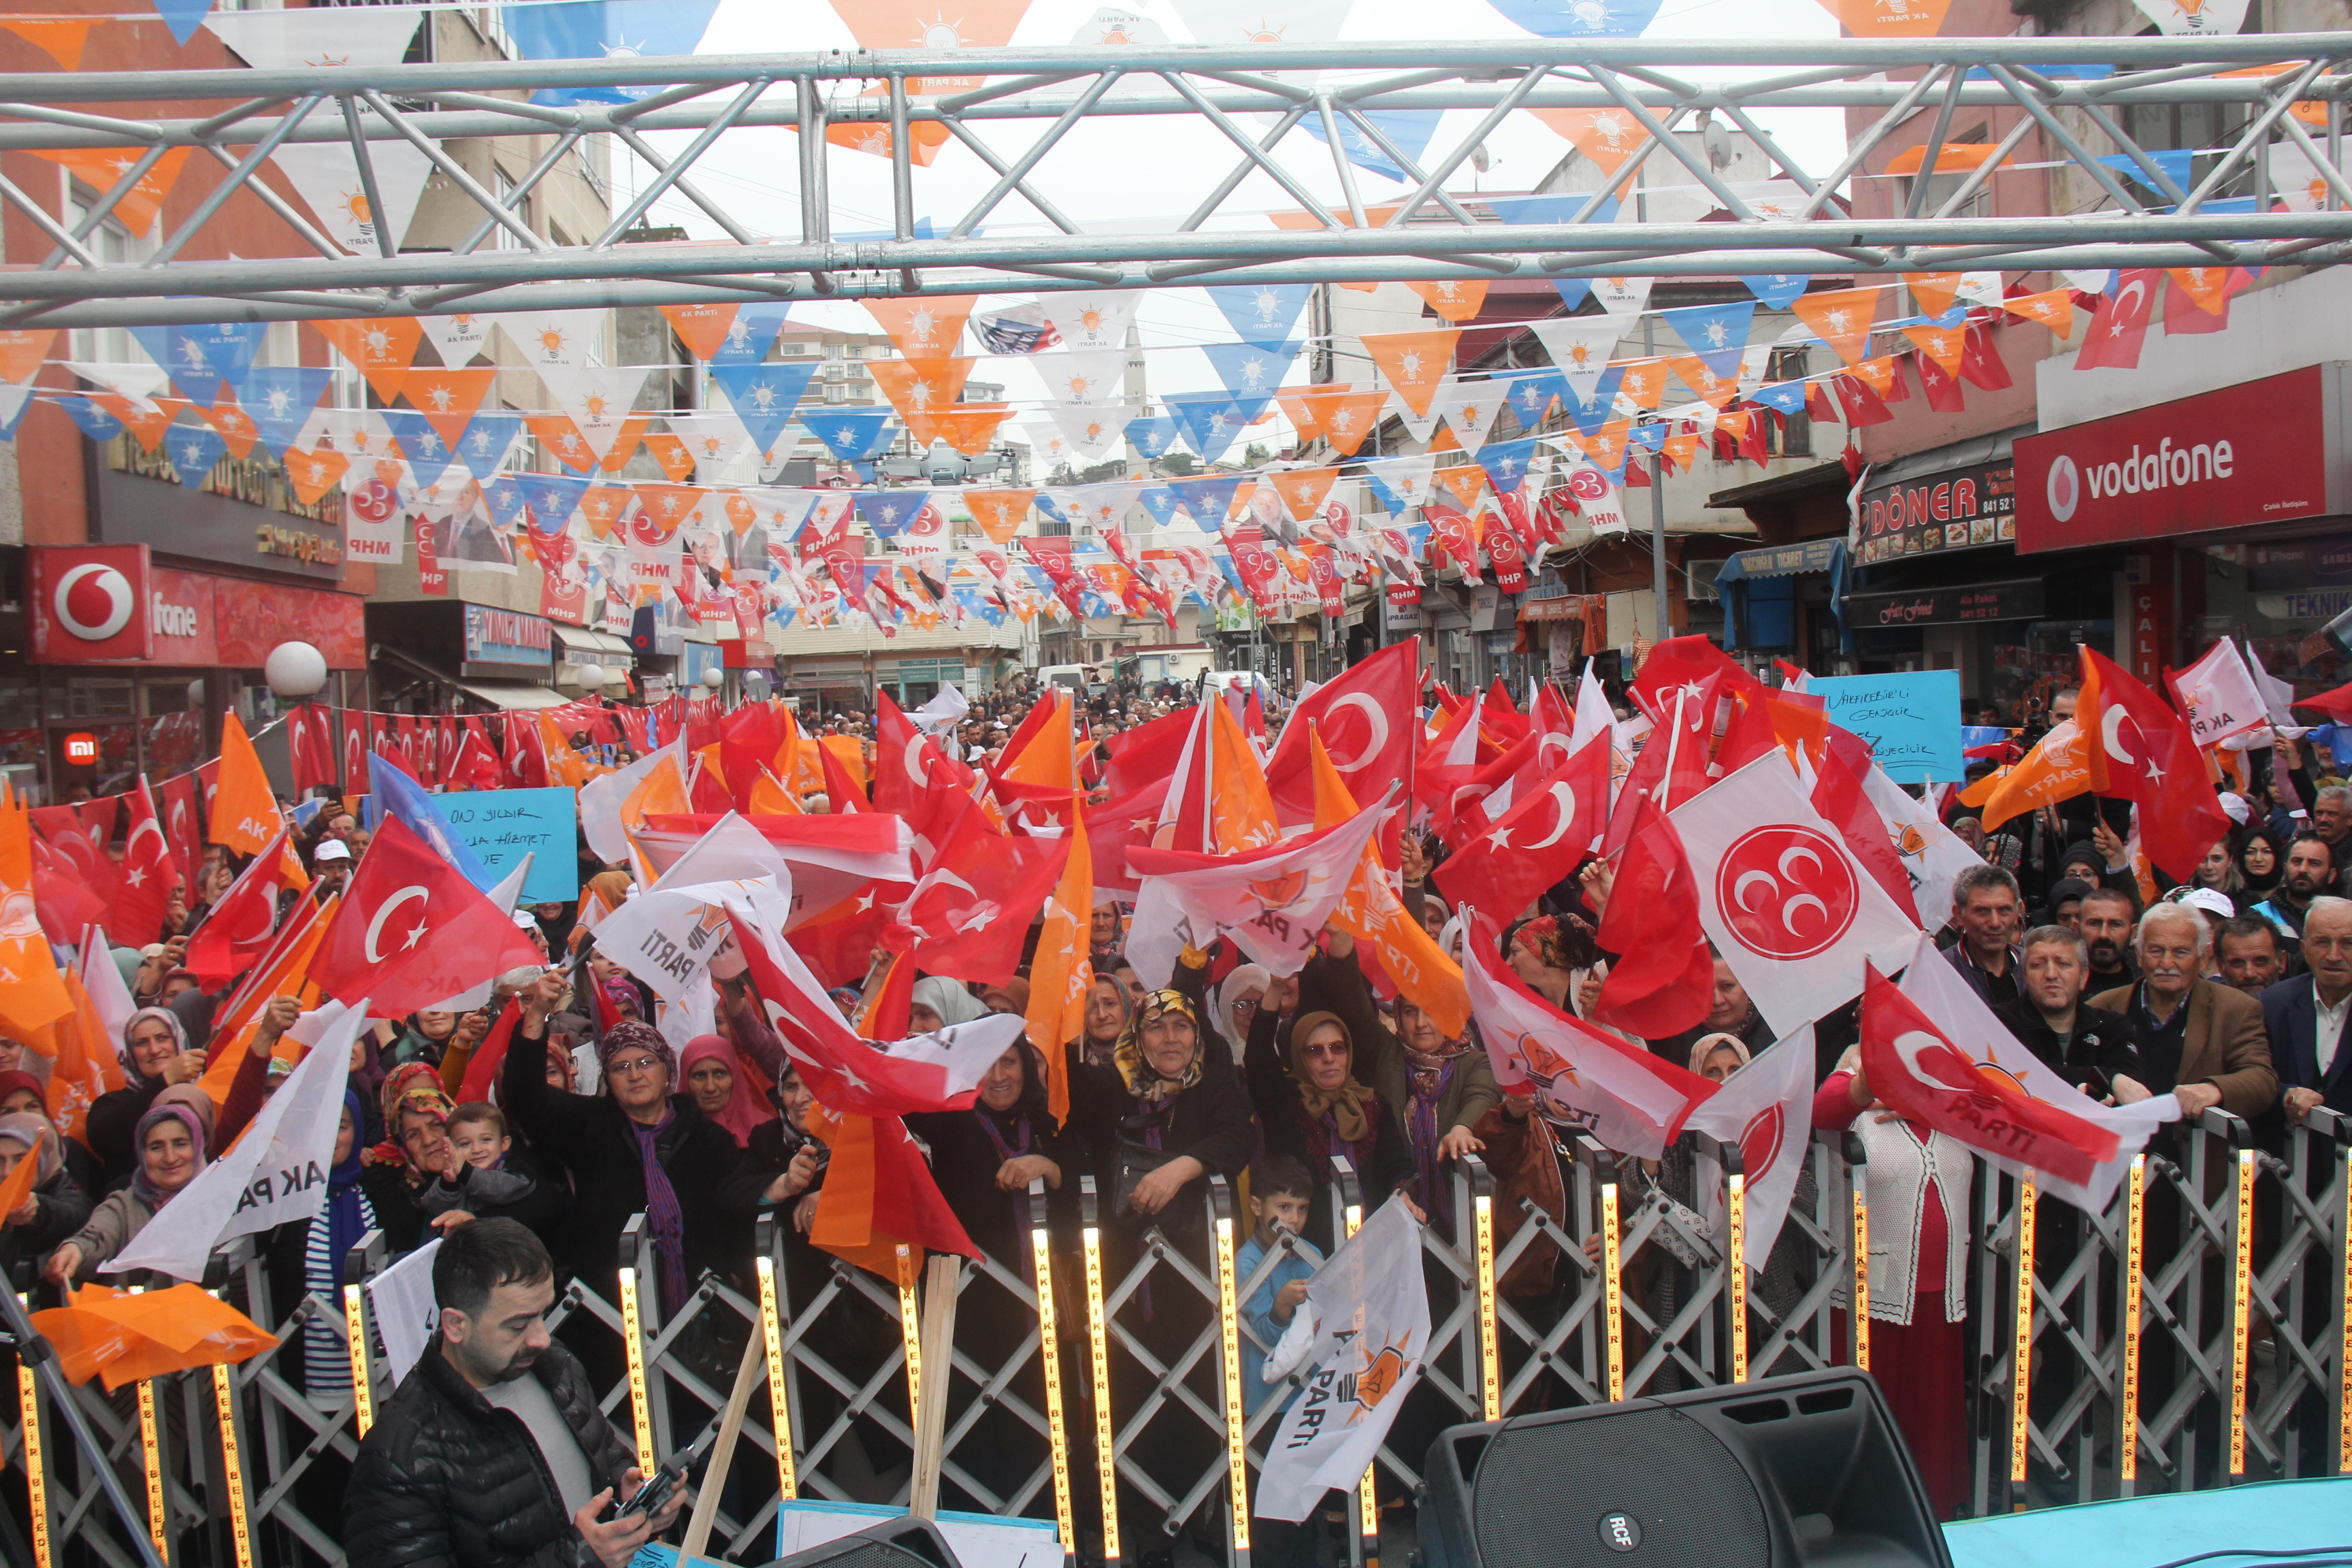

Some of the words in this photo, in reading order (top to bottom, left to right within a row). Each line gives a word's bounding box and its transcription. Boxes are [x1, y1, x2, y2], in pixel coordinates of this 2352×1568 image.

[2086, 437, 2234, 500] vodafone
[1871, 478, 1977, 536] DÖNER
[1983, 499, 1997, 513] 841
[1999, 497, 2010, 510] 52
[2270, 549, 2305, 561] iPhone
[421, 572, 444, 585] HP
[153, 591, 198, 638] fone
[548, 607, 577, 619] MHP
[700, 610, 727, 619] MHP
[451, 809, 475, 823] ON
[238, 816, 268, 842] AK
[1609, 1516, 1633, 1547] RCF
